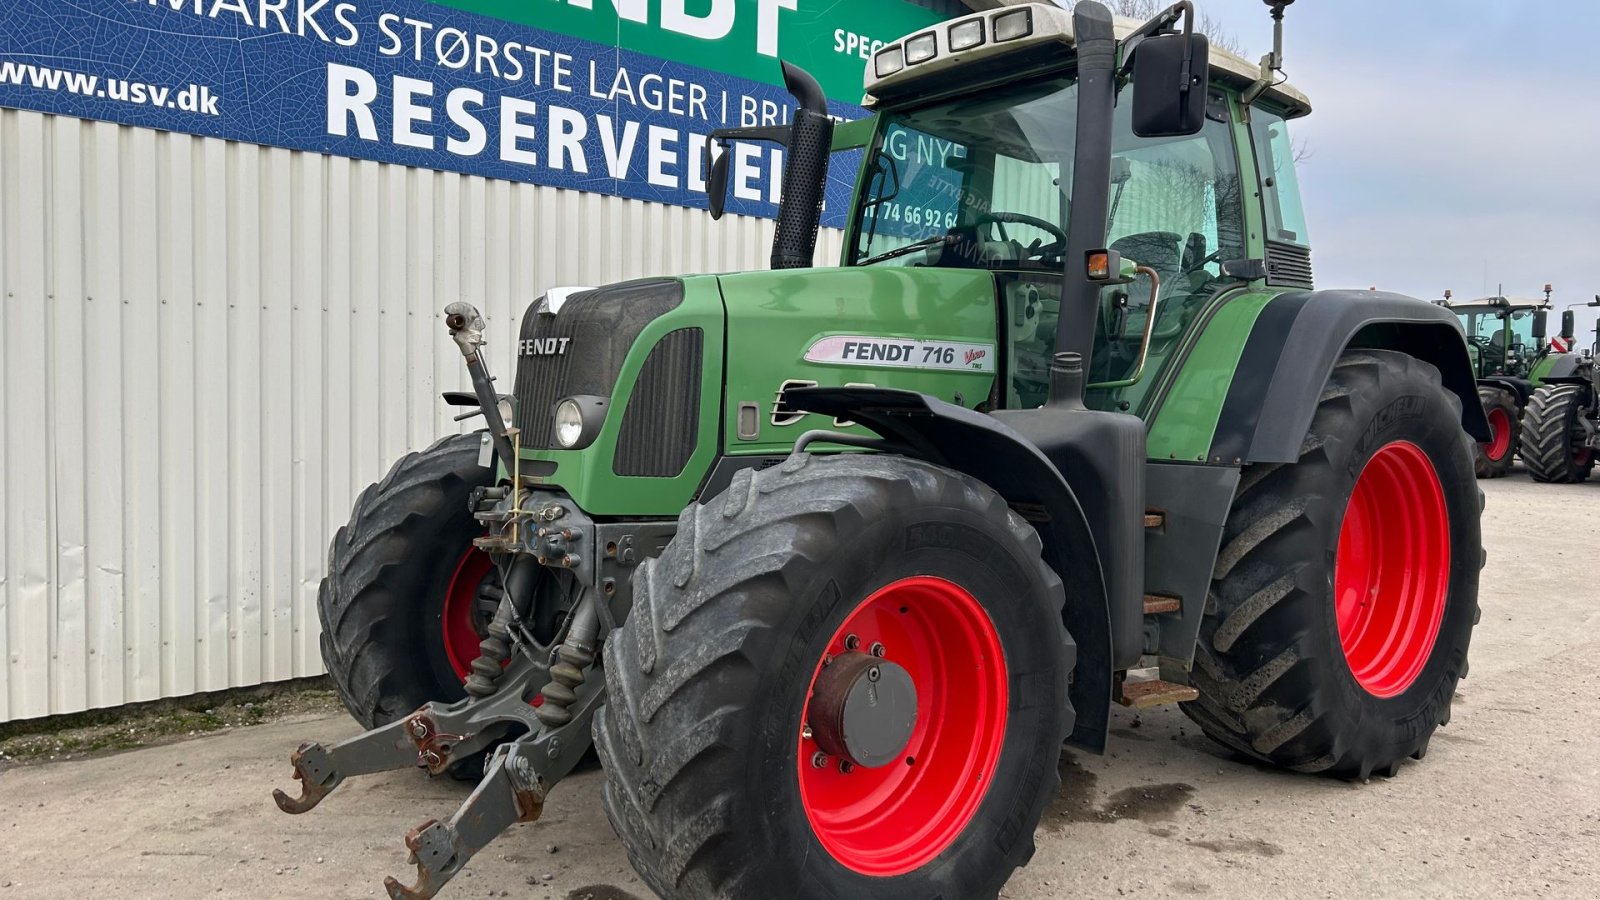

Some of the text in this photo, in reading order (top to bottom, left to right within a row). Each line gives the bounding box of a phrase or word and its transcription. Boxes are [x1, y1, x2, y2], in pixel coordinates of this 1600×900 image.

[834, 28, 889, 60] SPEC
[378, 13, 572, 92] STØRSTE
[589, 60, 708, 120] LAGER
[721, 90, 727, 124] I
[0, 62, 220, 116] www.usv.dk
[883, 201, 900, 221] 74
[904, 205, 921, 225] 66
[925, 208, 941, 228] 92
[518, 337, 570, 356] FENDT
[841, 341, 915, 362] FENDT
[922, 346, 955, 364] 716
